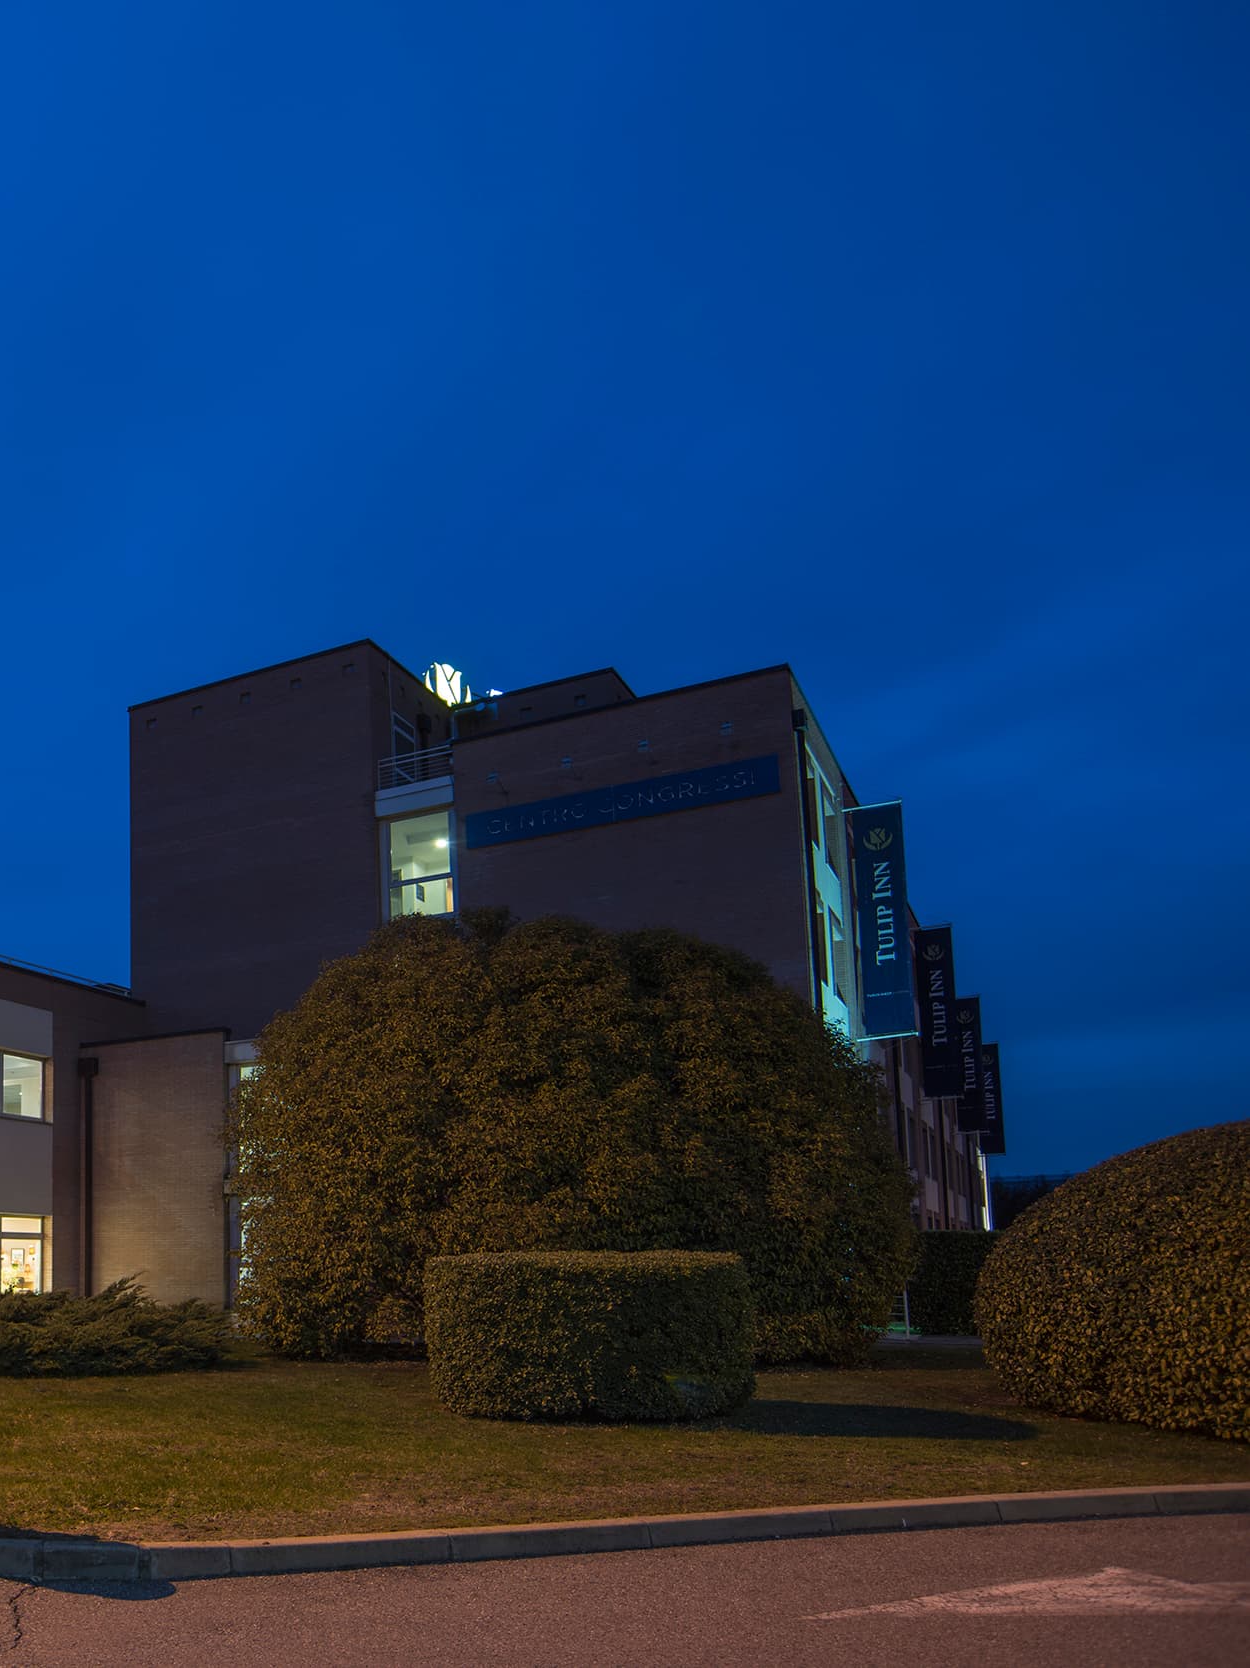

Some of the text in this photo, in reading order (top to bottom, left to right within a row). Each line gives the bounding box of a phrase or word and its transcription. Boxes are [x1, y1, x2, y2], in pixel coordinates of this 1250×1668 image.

[872, 861, 896, 966] TULIP INN
[929, 969, 944, 999] INN
[932, 1001, 948, 1047] TULIP
[962, 1031, 976, 1091] TULIP INN
